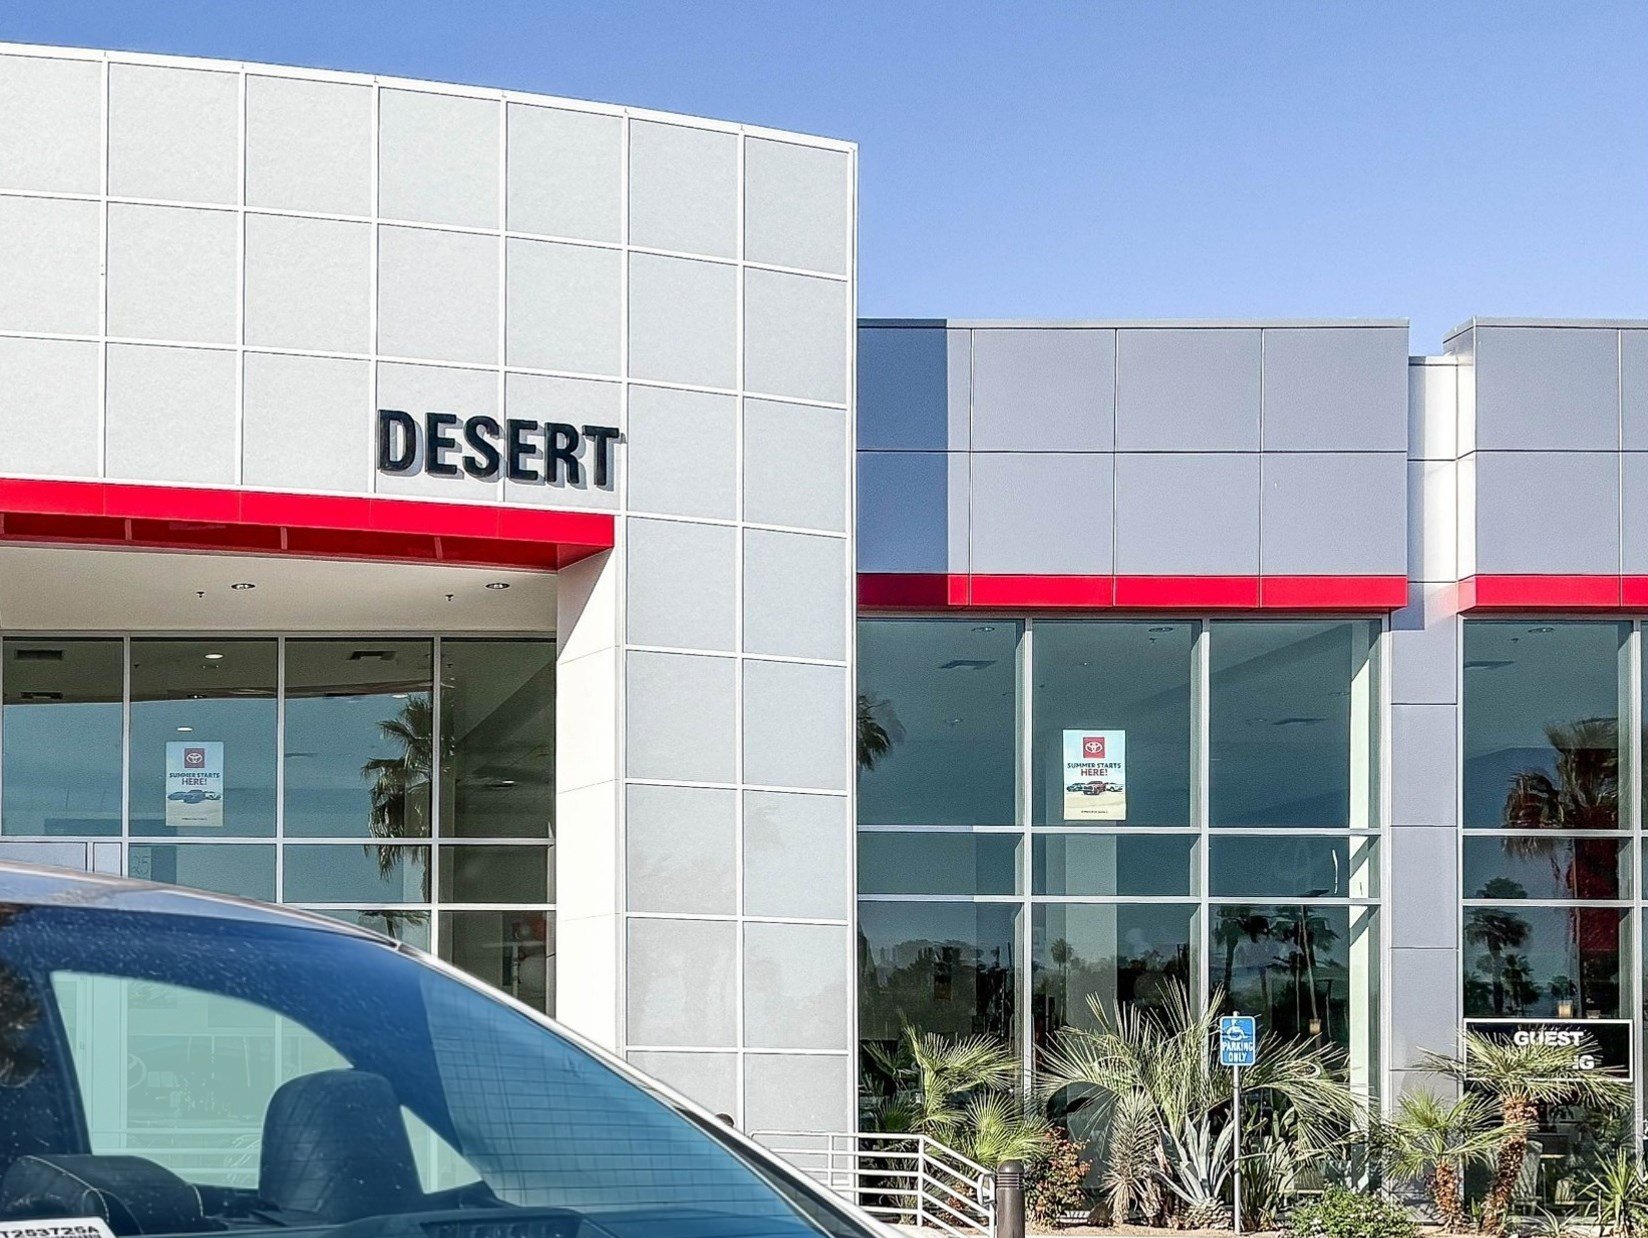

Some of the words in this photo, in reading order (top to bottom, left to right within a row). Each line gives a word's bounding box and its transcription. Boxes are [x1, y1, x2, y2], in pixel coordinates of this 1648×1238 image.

[377, 409, 620, 487] DESERT
[1081, 768, 1108, 777] HERE!
[181, 778, 207, 786] HERE!
[1513, 1030, 1584, 1047] GUEST
[1222, 1041, 1254, 1052] PARKING
[1228, 1052, 1248, 1063] ONLY
